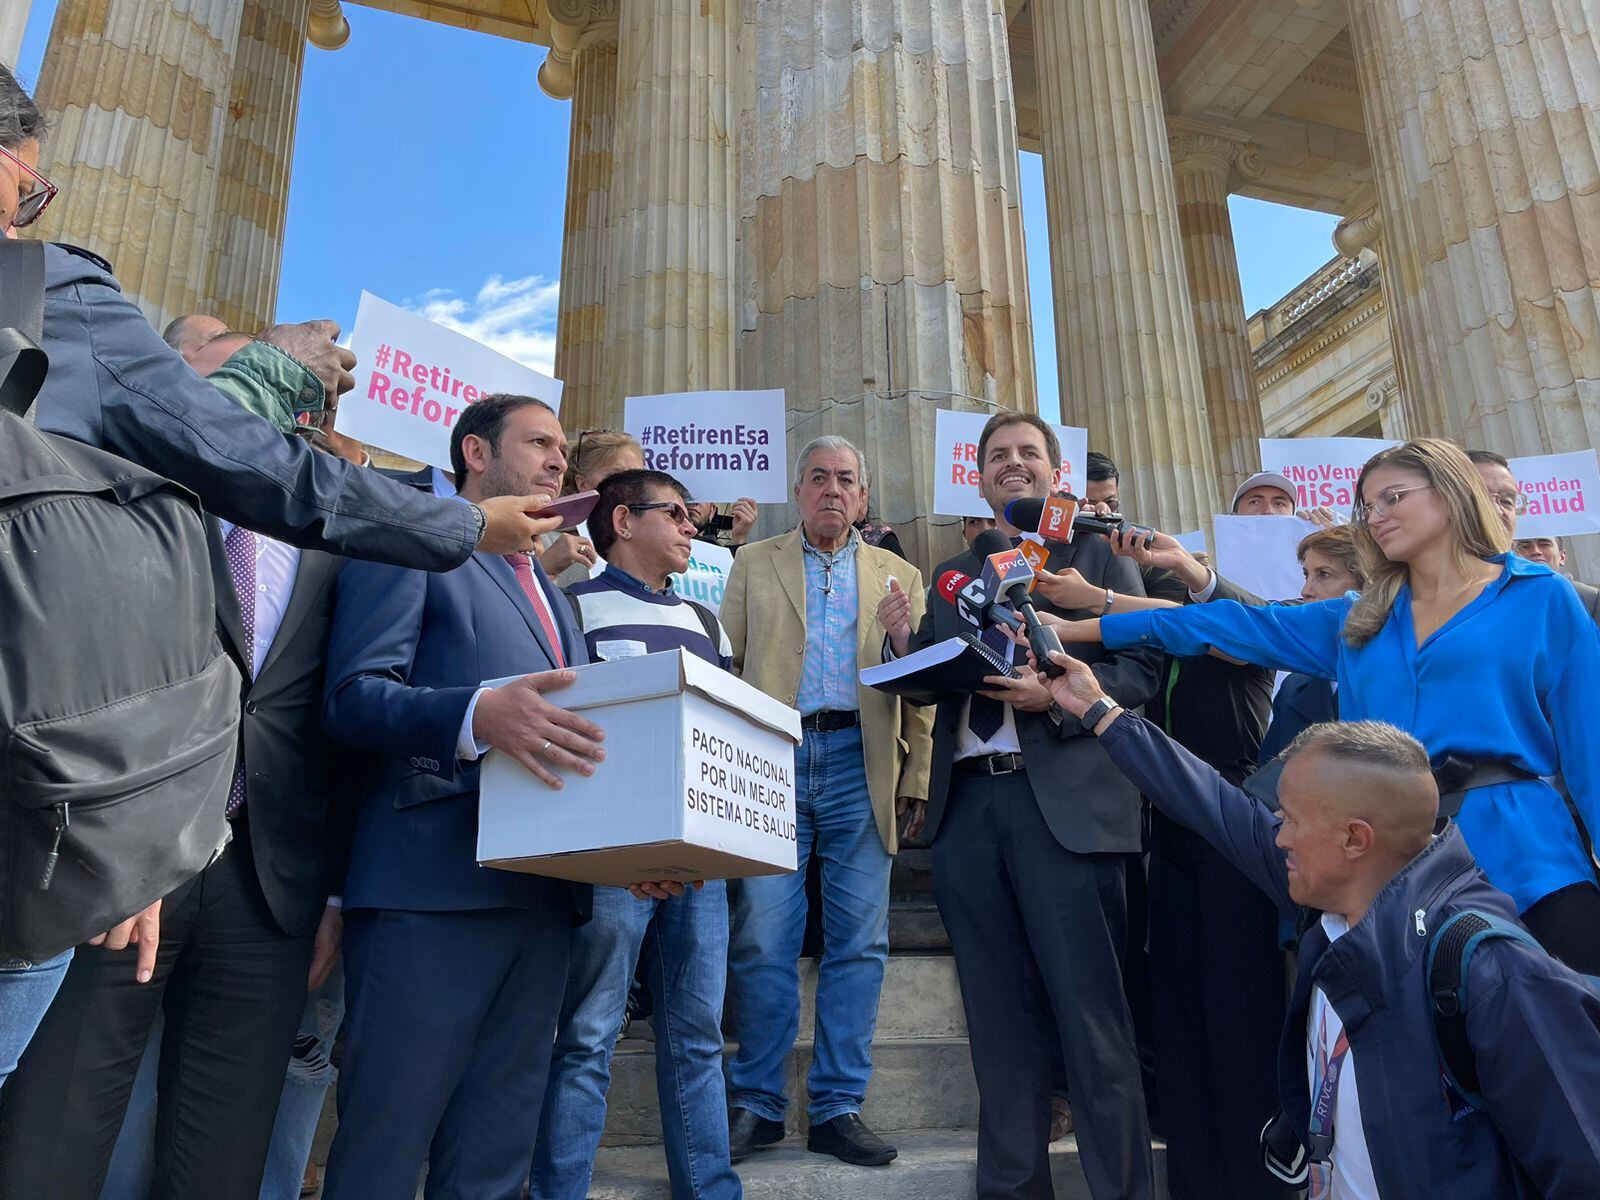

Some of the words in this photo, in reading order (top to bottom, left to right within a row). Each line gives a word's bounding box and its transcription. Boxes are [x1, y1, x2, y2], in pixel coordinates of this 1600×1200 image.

[367, 371, 462, 427] Refor
[641, 423, 769, 445] #RetirenEsa
[643, 446, 769, 471] ReformaYa
[1522, 491, 1585, 515] alud
[997, 559, 1025, 571] RTVC
[692, 728, 733, 763] PACTO
[737, 747, 791, 788] NACIONAL
[701, 761, 727, 790] POR
[730, 773, 746, 797] UN
[749, 781, 786, 812] MEJOR
[687, 787, 743, 825] SISTEMA
[745, 807, 760, 830] DE
[762, 814, 797, 841] SALUD
[1317, 1081, 1332, 1118] RTVC
